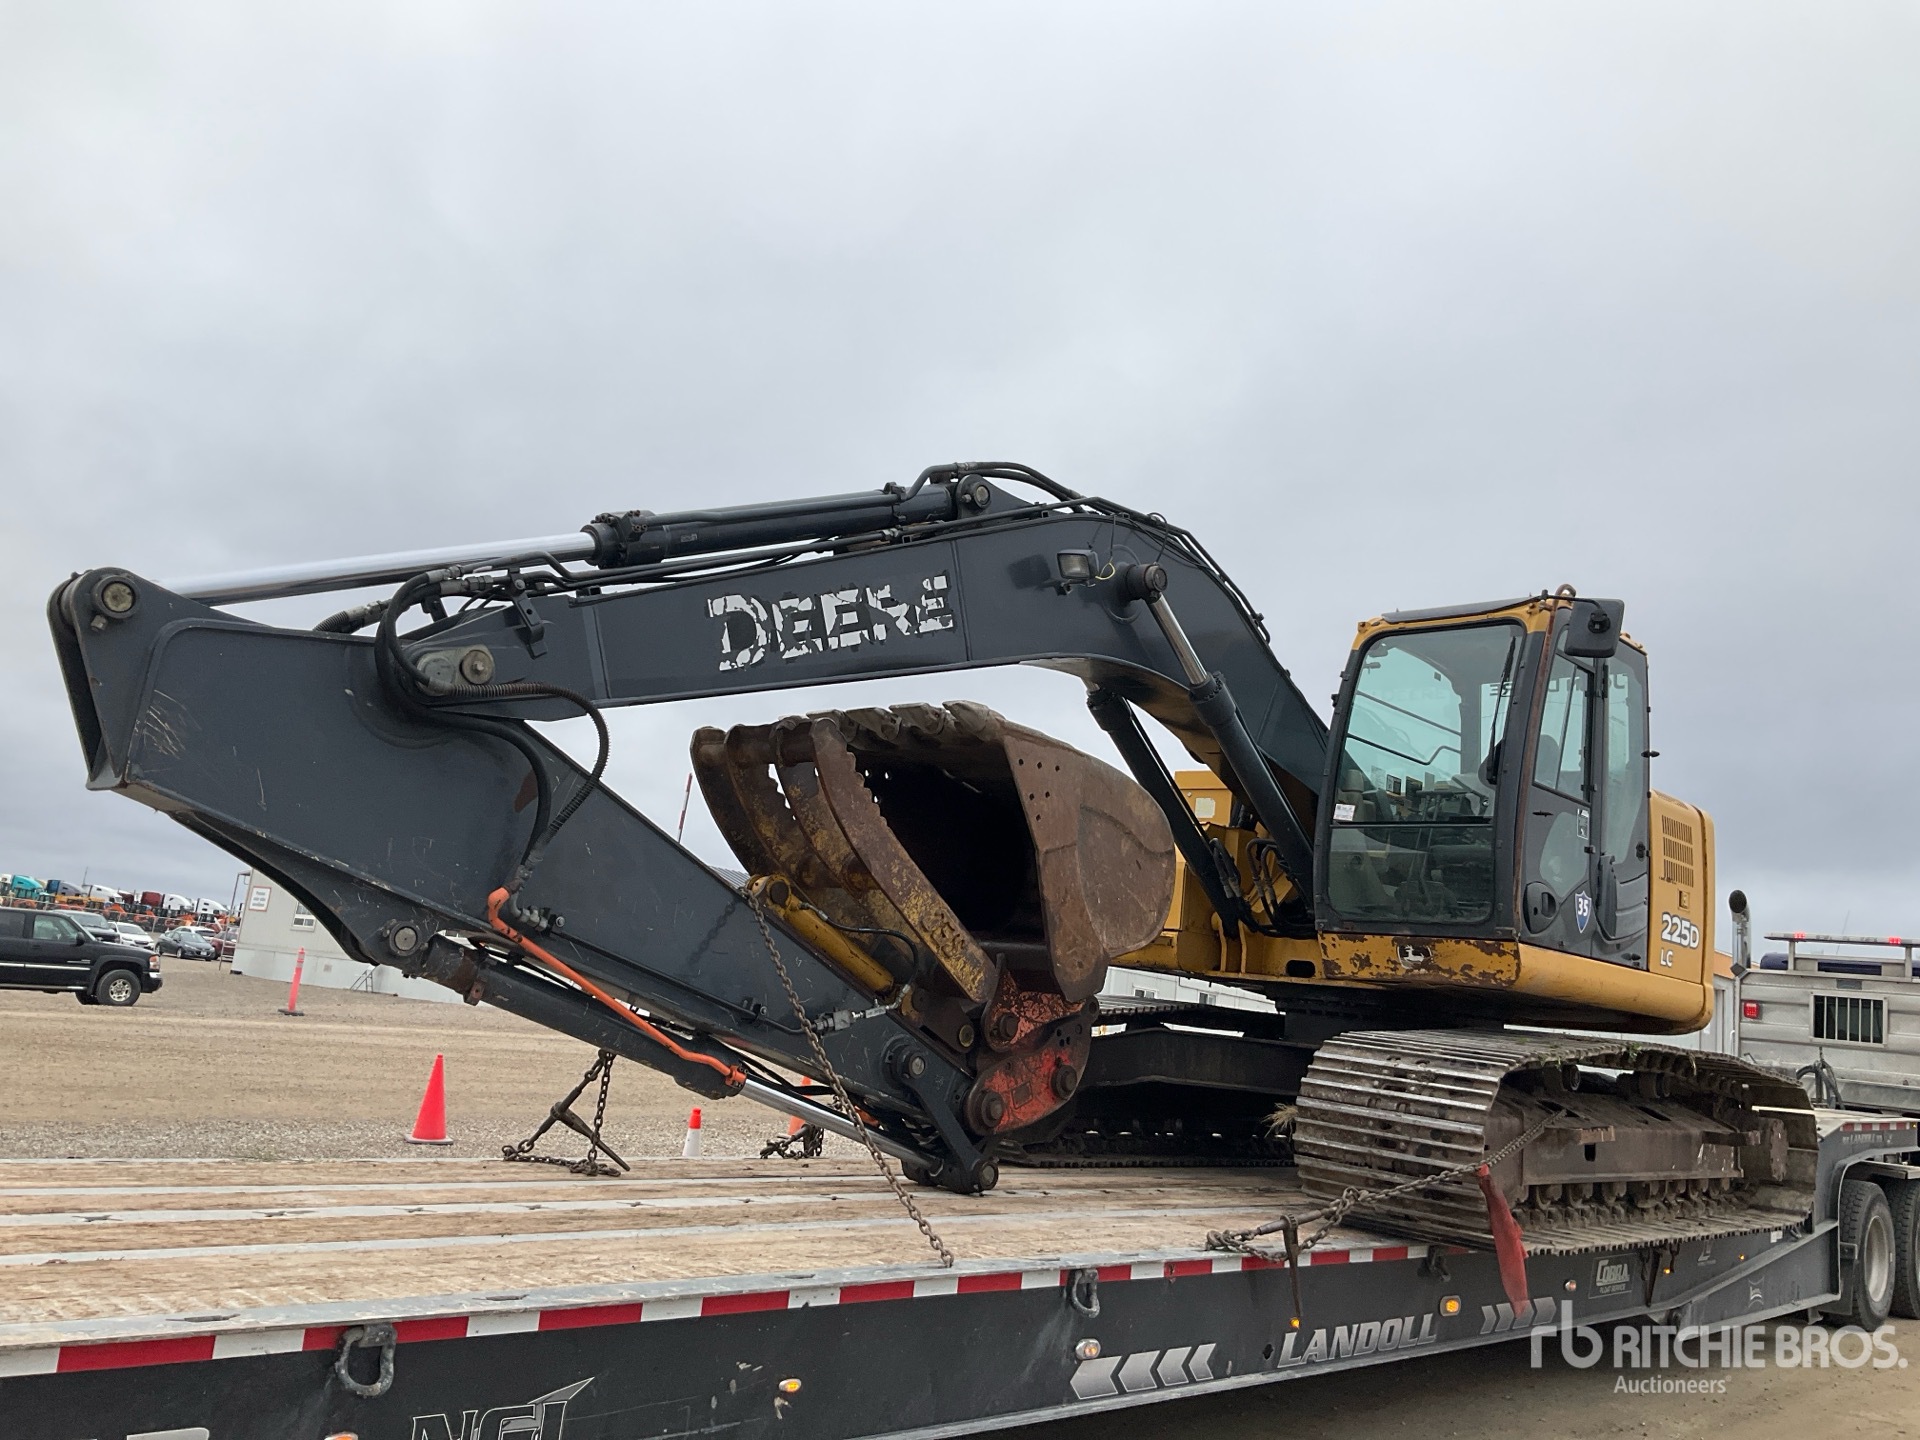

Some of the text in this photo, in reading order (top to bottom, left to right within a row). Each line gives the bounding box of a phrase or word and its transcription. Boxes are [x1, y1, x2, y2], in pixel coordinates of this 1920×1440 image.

[707, 575, 954, 672] DEERE
[1577, 897, 1589, 917] 35
[1661, 912, 1701, 949] 225D
[1660, 949, 1675, 968] LC
[1596, 1259, 1630, 1285] COBRA
[1277, 1313, 1437, 1368] LANDOLL
